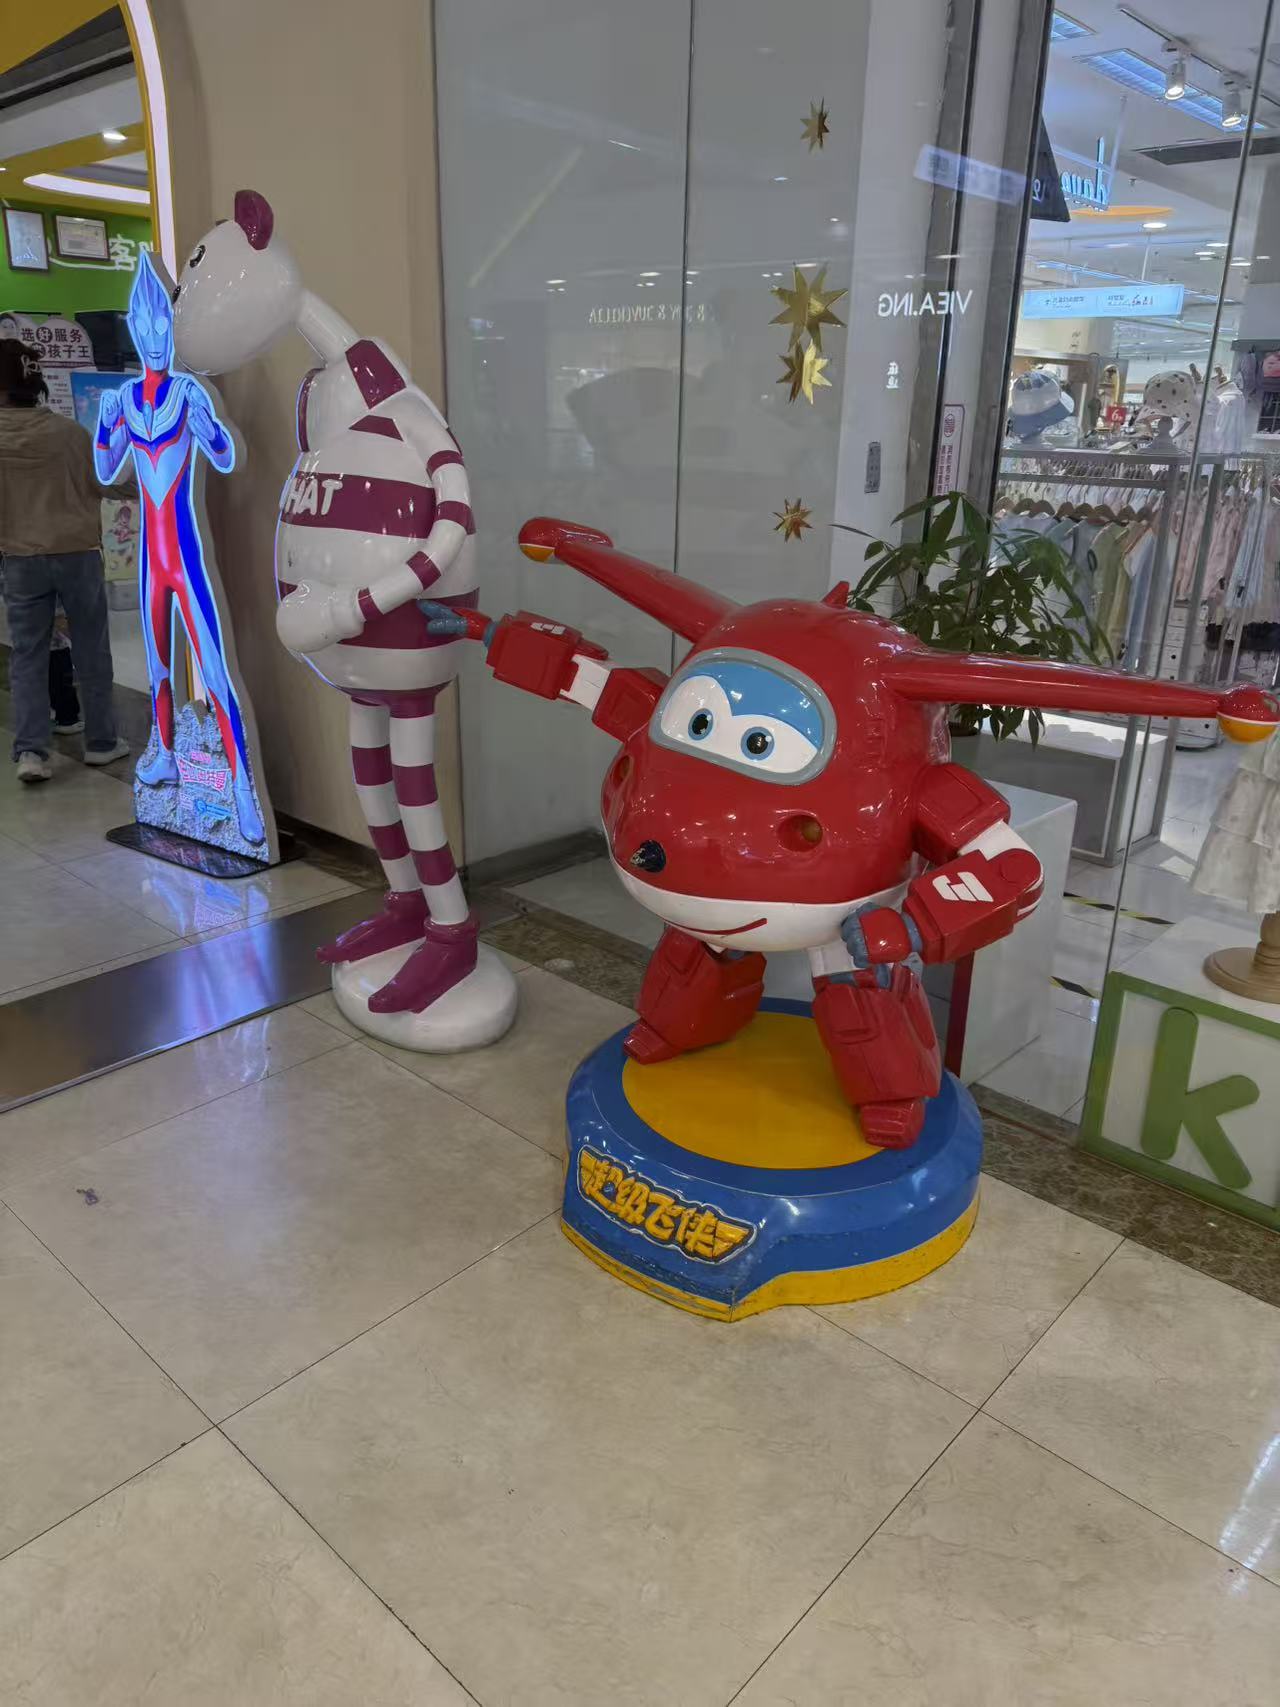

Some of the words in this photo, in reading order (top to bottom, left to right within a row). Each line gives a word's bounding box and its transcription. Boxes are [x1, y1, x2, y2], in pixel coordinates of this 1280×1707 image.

[109, 233, 154, 271] 客
[21, 326, 83, 343] 选好服务
[284, 478, 343, 516] HAT
